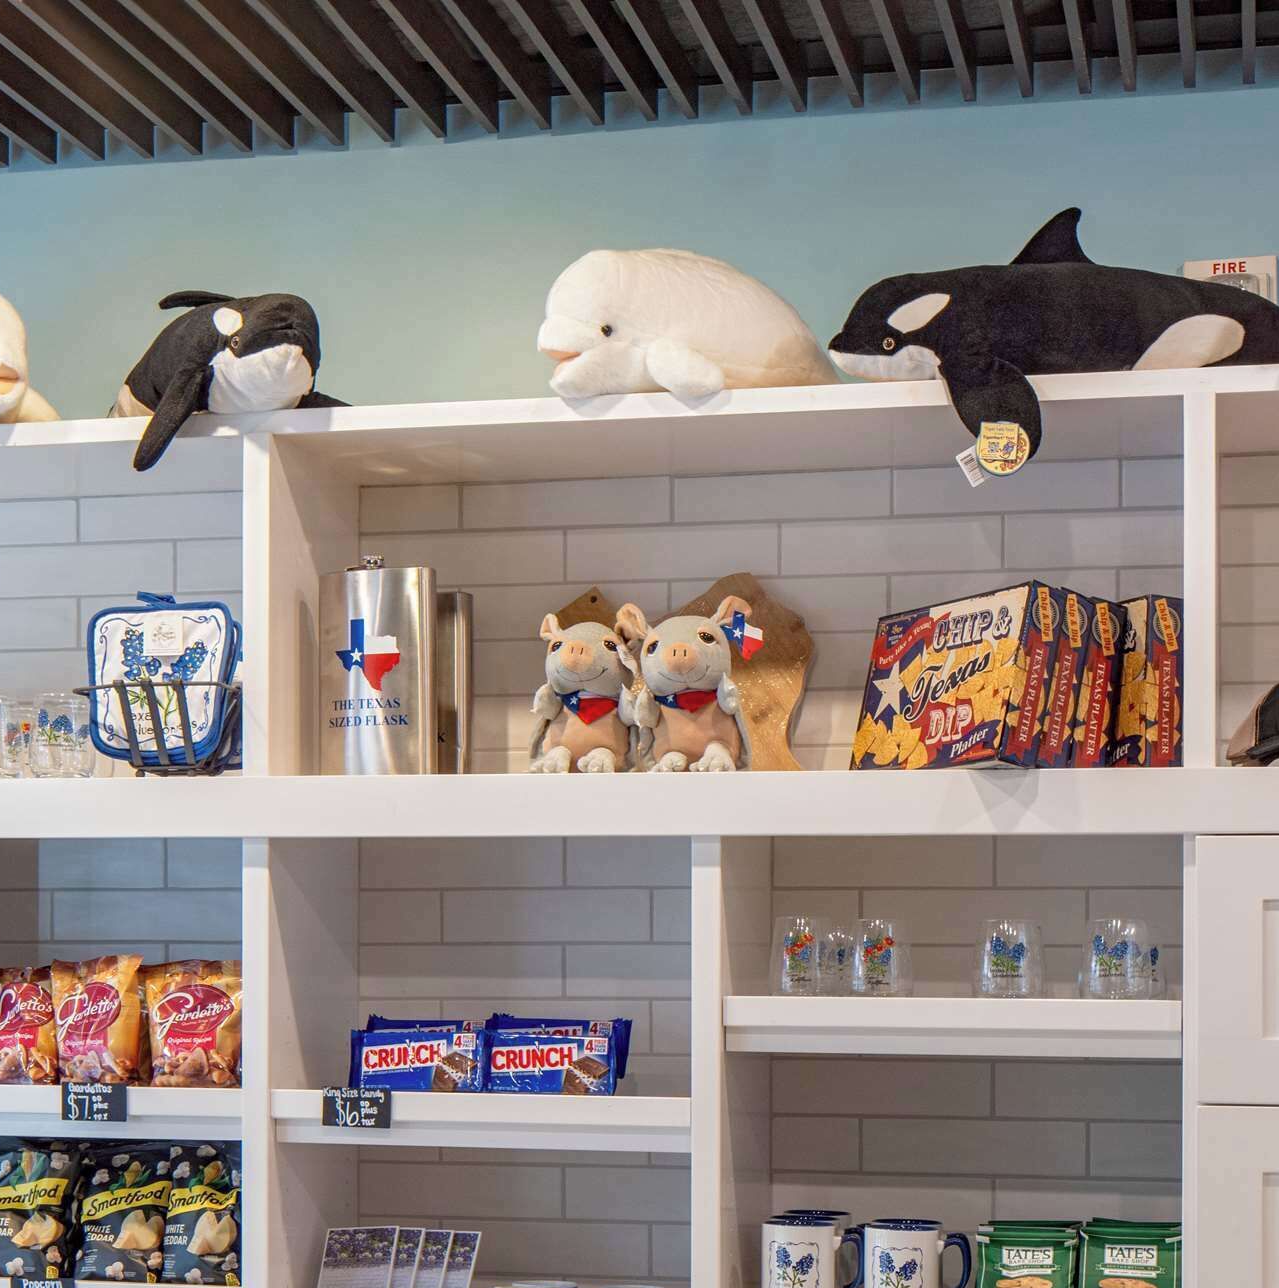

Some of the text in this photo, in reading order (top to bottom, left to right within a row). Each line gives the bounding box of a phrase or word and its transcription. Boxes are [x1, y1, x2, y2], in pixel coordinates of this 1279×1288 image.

[1213, 261, 1247, 274] FIRE
[1039, 590, 1048, 611] Chip
[1069, 597, 1077, 618] Chip
[1098, 606, 1107, 628] Chip
[1157, 600, 1166, 620] Chip
[1165, 631, 1174, 648] Dip
[933, 605, 1013, 652] CHIP &
[1043, 623, 1051, 638] Dip
[1072, 629, 1080, 645] Dip
[903, 651, 992, 722] Texas
[1018, 648, 1044, 742] TEXAS PLATTER
[332, 698, 401, 711] THE TEXAS
[1048, 653, 1073, 747] TEXAS PLATTER
[1085, 663, 1106, 756] TEXAS PLATTER
[1161, 660, 1171, 755] TEXAS PLATTER
[329, 714, 408, 728] SIZED FLASK
[925, 703, 973, 745] DIP
[949, 728, 989, 758] Platter
[151, 990, 231, 1041] Gardetto's
[589, 1022, 598, 1035] 4
[454, 1035, 462, 1047] 4
[584, 1039, 594, 1053] 4
[364, 1043, 442, 1070] CRUNCH
[492, 1046, 574, 1071] CRUNCH
[322, 1087, 385, 1103] King Size Candy
[87, 1187, 166, 1217] Smartfood
[84, 1224, 112, 1235] WHITE
[1004, 1248, 1052, 1260] TATE'S
[1107, 1246, 1155, 1259] TATE'S
